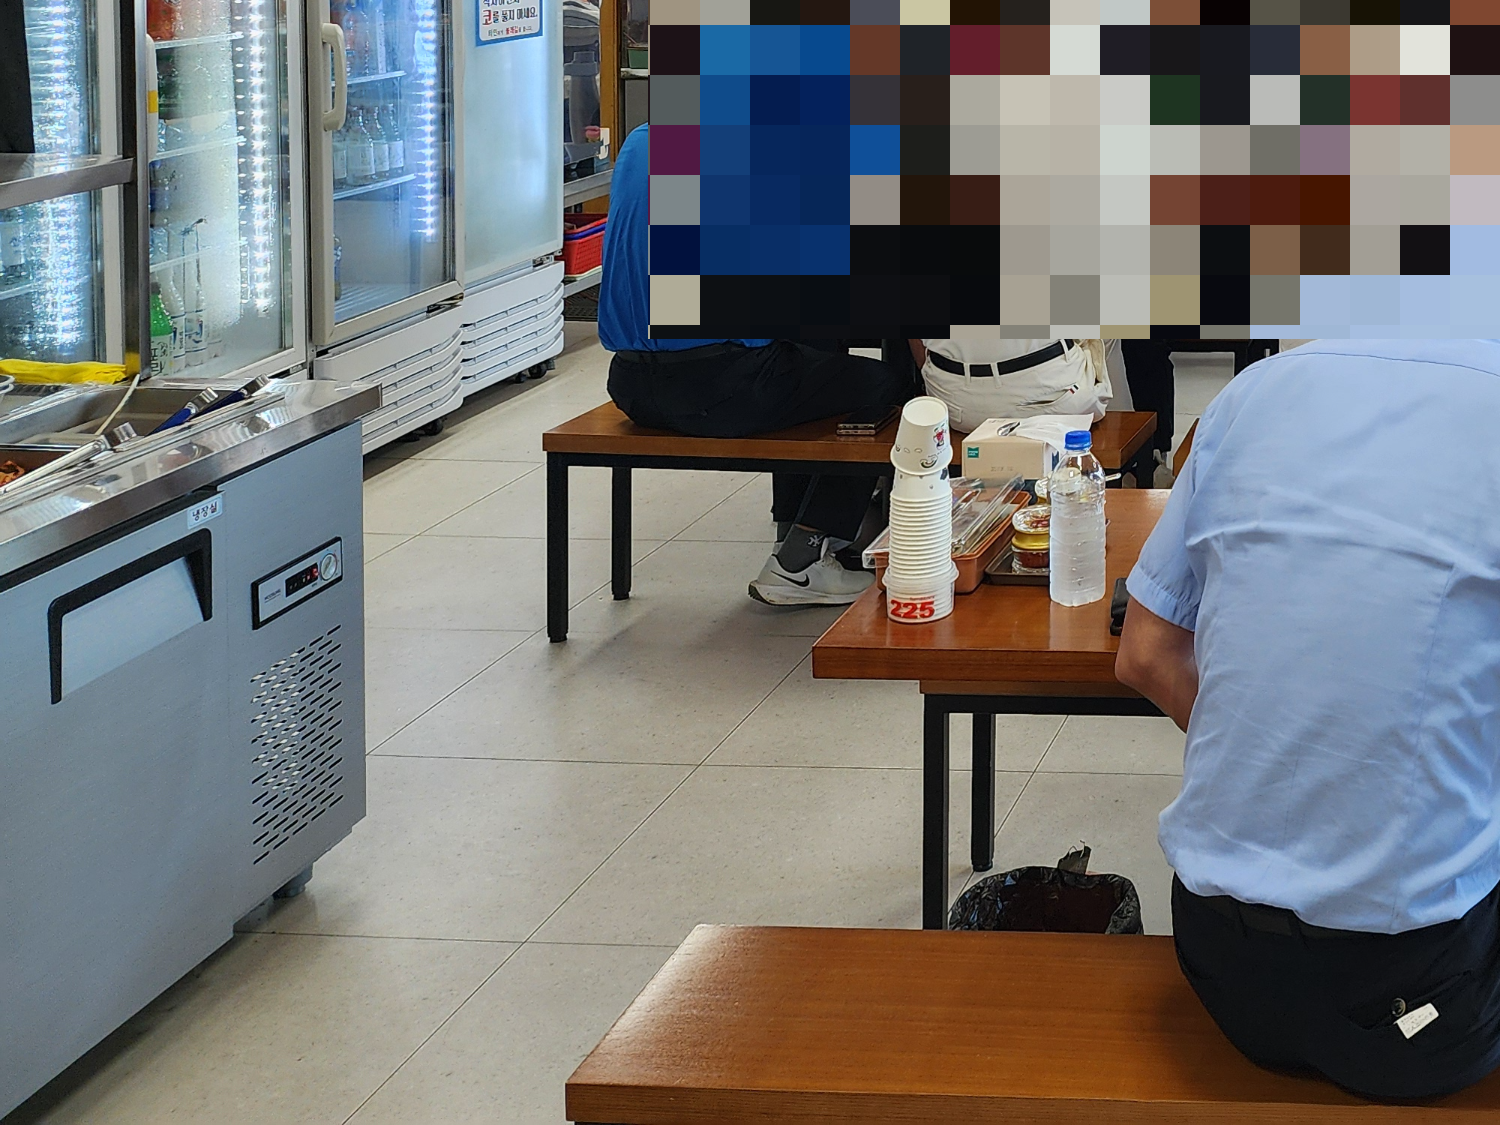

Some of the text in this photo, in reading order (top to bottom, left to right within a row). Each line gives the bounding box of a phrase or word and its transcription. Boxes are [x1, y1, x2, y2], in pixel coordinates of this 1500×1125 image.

[482, 9, 499, 26] 코를
[516, 6, 538, 20] 마세요.
[192, 501, 218, 522] 냉장실
[890, 599, 935, 619] 225
